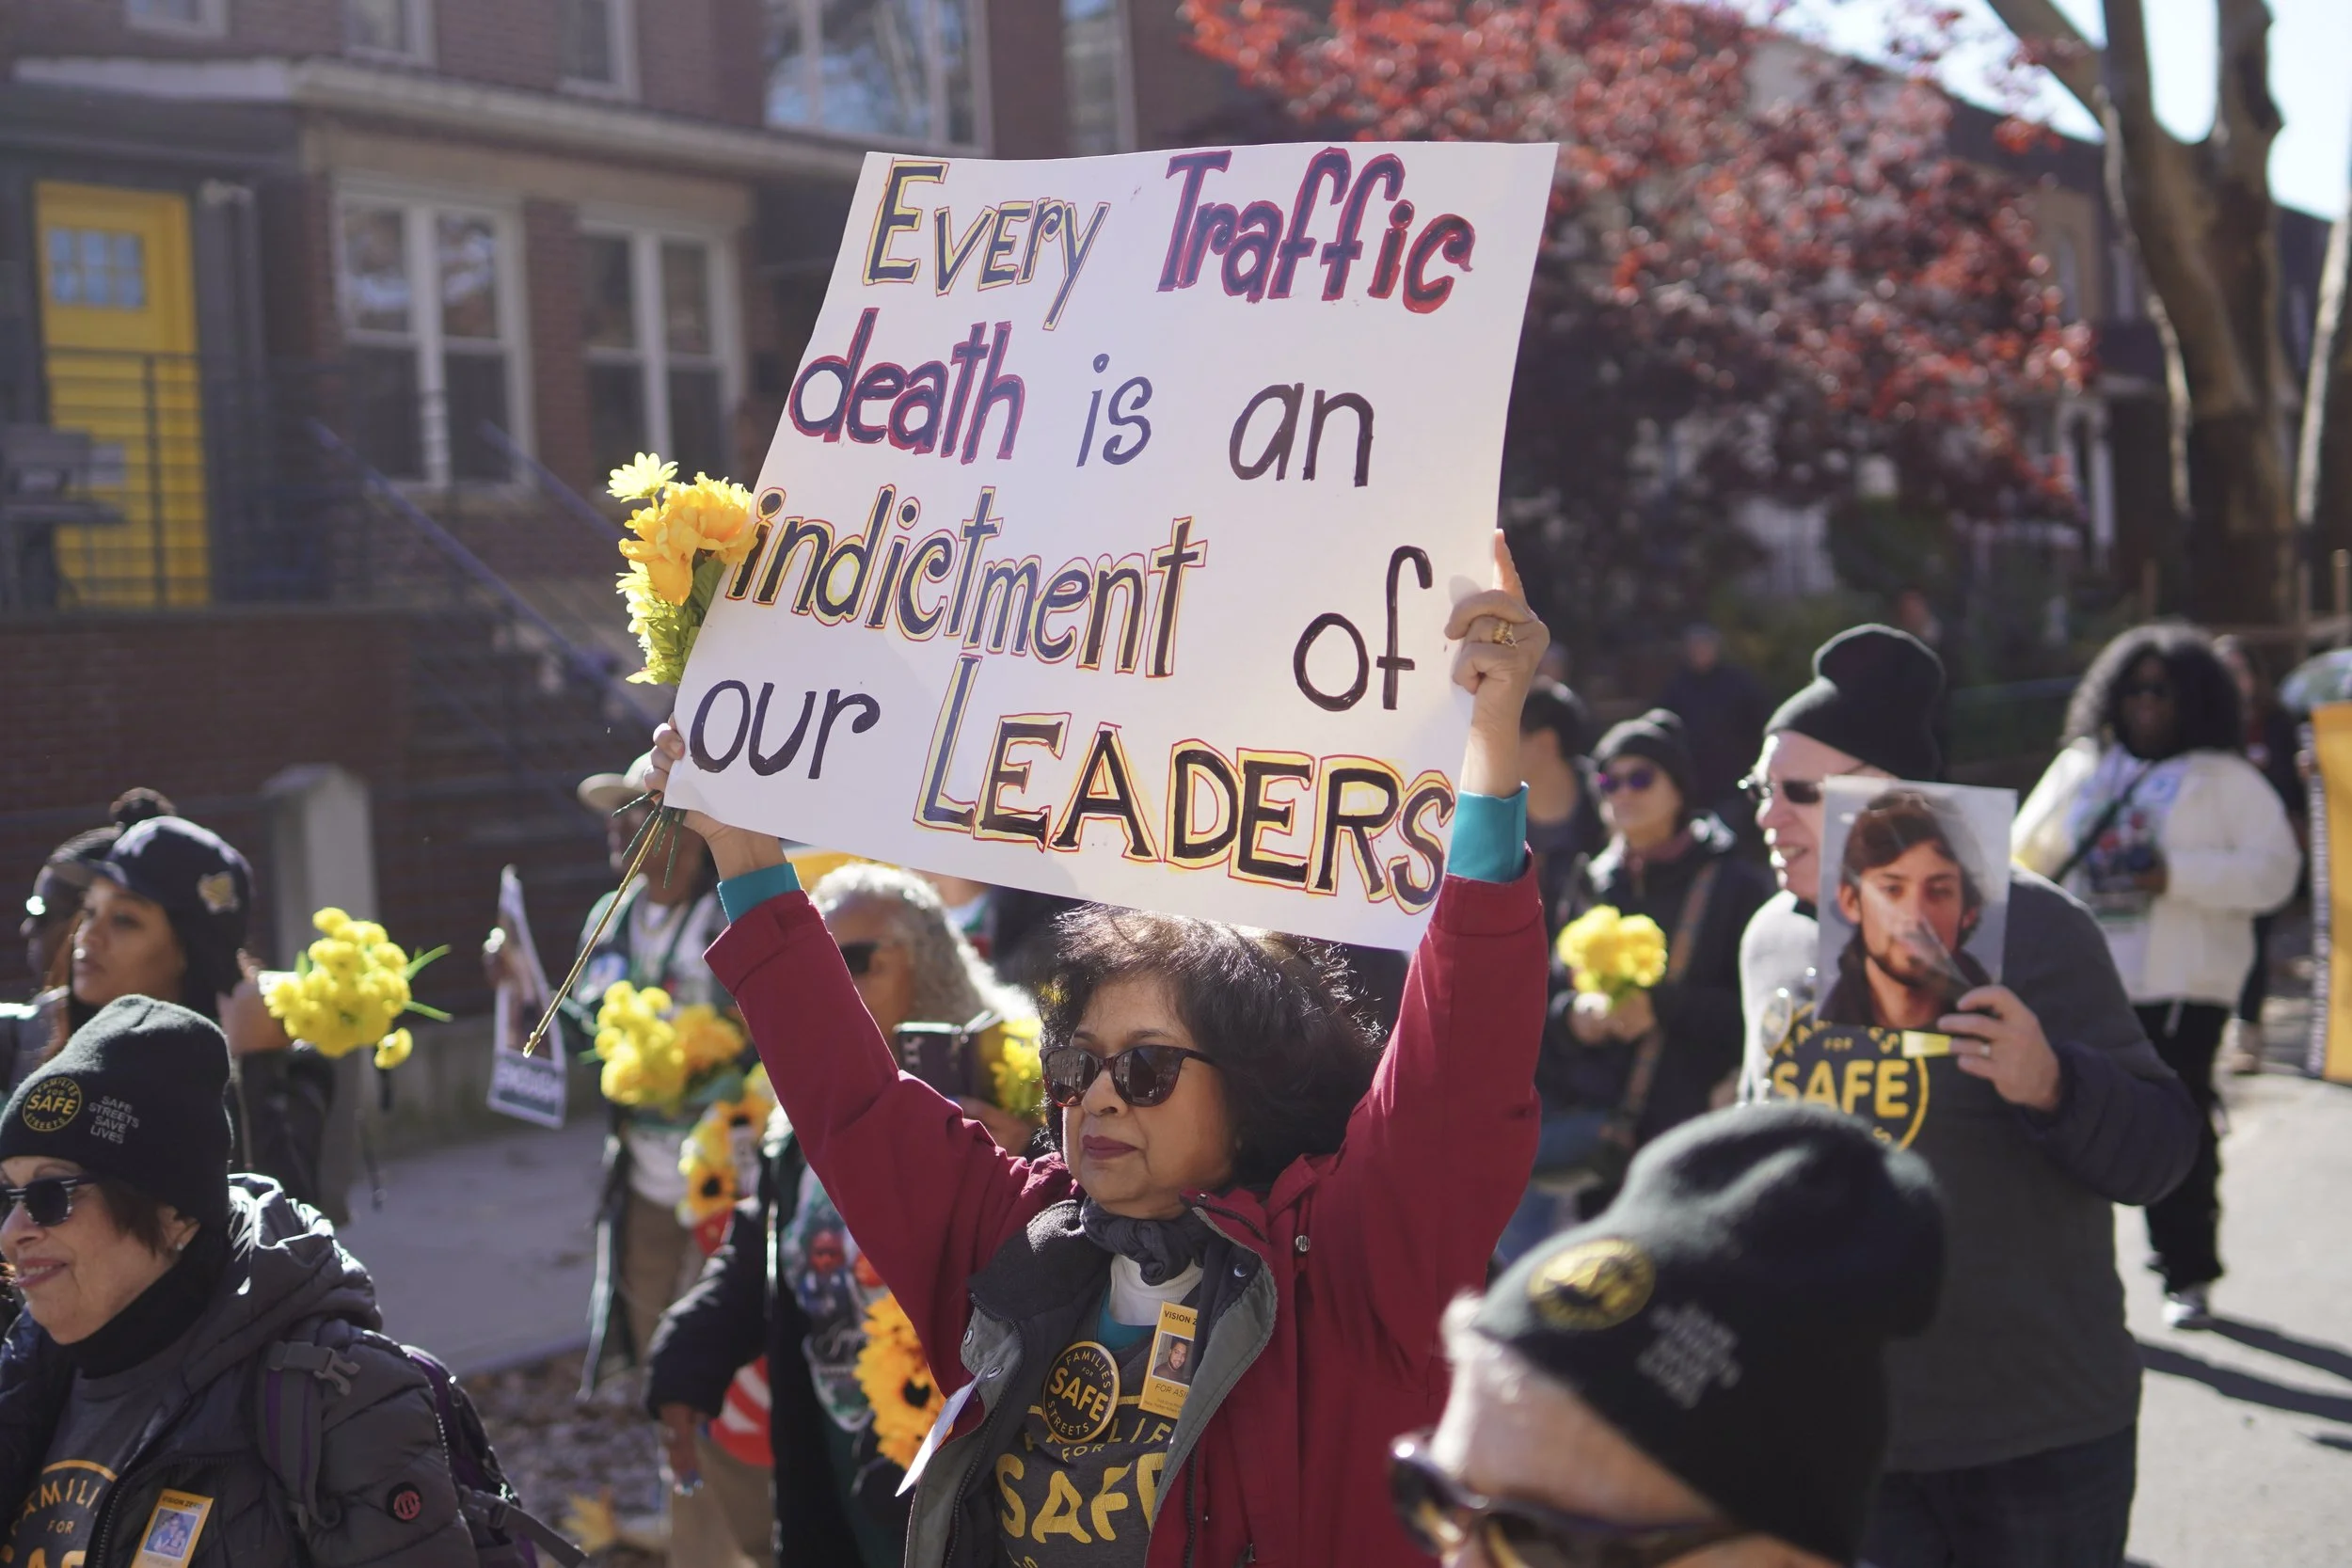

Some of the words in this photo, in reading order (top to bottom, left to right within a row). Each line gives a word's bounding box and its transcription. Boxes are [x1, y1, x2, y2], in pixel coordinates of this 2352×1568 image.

[1157, 147, 1474, 314] Traffic
[789, 307, 1025, 464] death
[1076, 353, 1153, 468] is
[1229, 382, 1375, 487] an
[725, 486, 1207, 678] indictment
[1293, 546, 1433, 711] of
[688, 679, 882, 780] our
[913, 653, 1454, 916] LEADERS
[37, 1077, 78, 1097] FAMILIES
[1772, 1059, 1910, 1118] SAFE
[26, 1094, 77, 1116] SAFE
[88, 1101, 141, 1129] STREETS
[101, 1095, 134, 1114] SAFE
[24, 1112, 67, 1130] STREETS
[95, 1115, 128, 1134] SAVE
[89, 1125, 125, 1145] LIVES
[1164, 1309, 1191, 1325] VISION
[1065, 1350, 1112, 1389] FAMILIES
[1081, 1366, 1095, 1378] FOR
[1049, 1367, 1110, 1422] SAFE
[1155, 1383, 1172, 1393] FOR
[1047, 1400, 1089, 1435] STREETS
[1061, 1444, 1105, 1464] FOR
[47, 1519, 75, 1535] FOR
